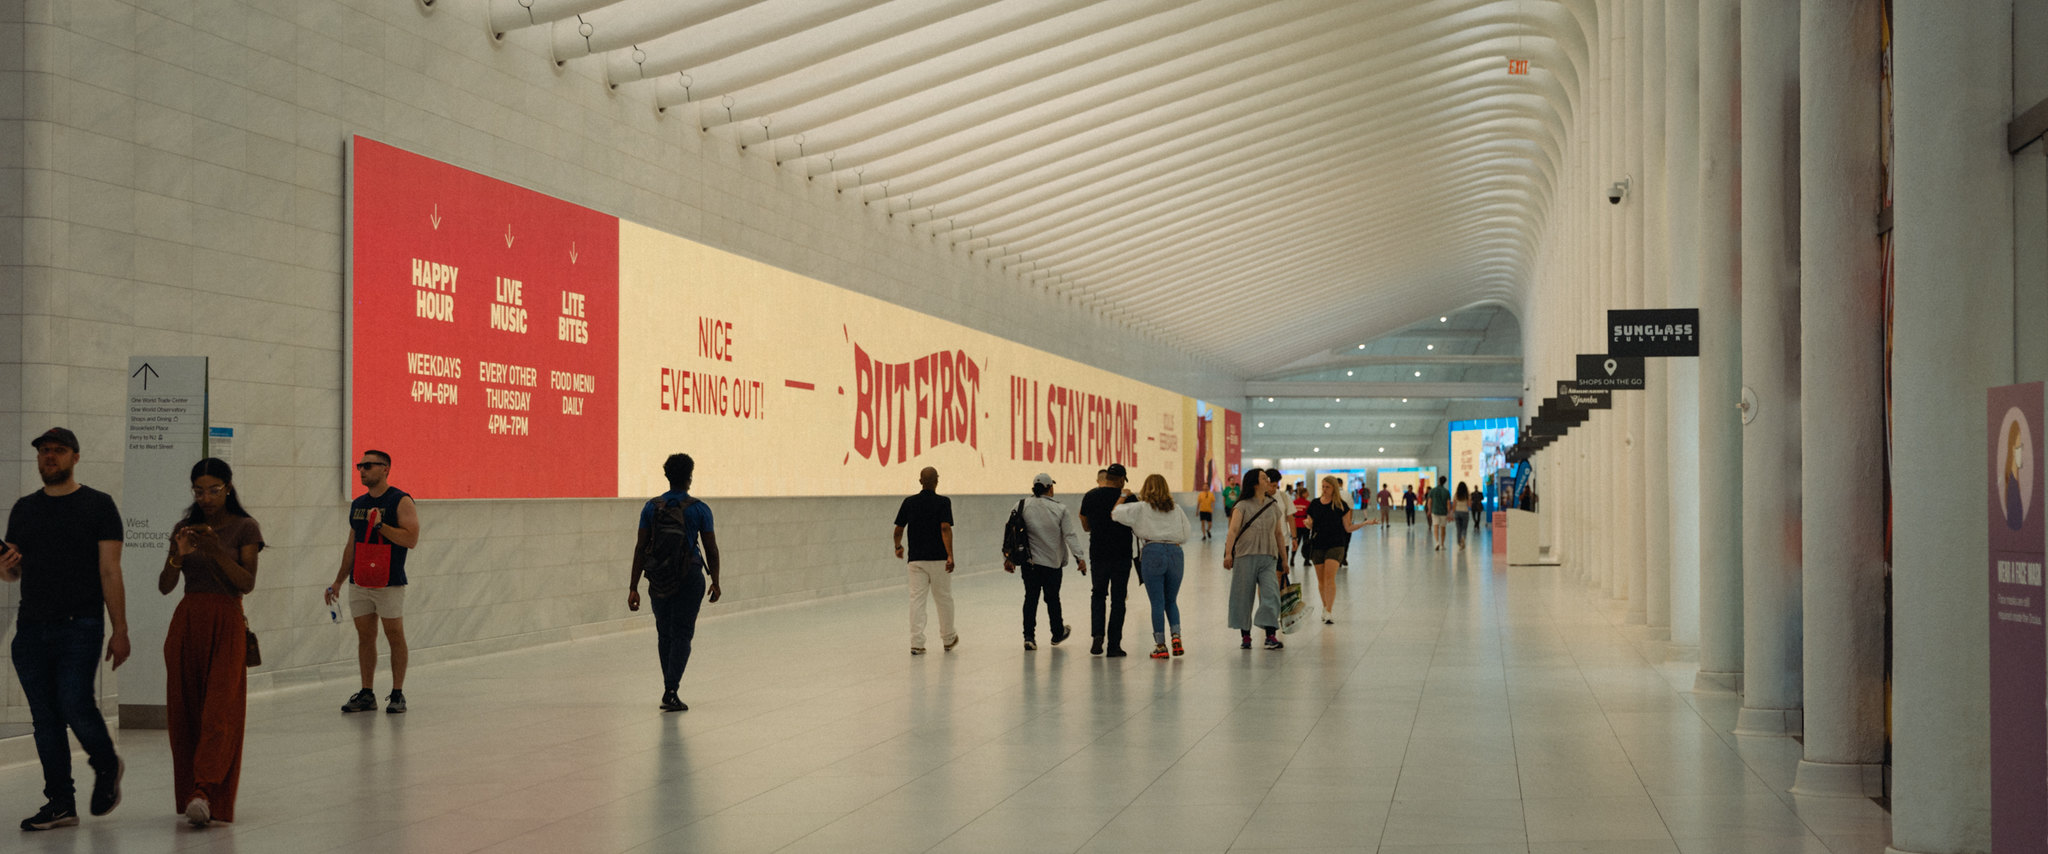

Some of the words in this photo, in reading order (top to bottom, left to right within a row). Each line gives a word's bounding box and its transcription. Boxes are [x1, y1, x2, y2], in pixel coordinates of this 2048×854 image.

[1508, 59, 1529, 75] EXIT
[412, 257, 459, 293] HAPPY
[496, 276, 523, 306] LIVE
[562, 290, 586, 318] LITE
[416, 289, 454, 323] HOUR
[490, 303, 528, 334] MUSIC
[558, 316, 589, 344] BITES
[698, 316, 733, 362] NICE
[1614, 324, 1693, 336] SUNGLASS
[407, 351, 462, 379] WEEKDAYS
[479, 360, 508, 384] EVERY
[508, 364, 537, 388] OTHER
[550, 370, 572, 391] FOOD
[572, 373, 595, 394] MENU
[660, 367, 728, 417] EVENING
[732, 377, 764, 420] OUT!
[1579, 378, 1602, 386] SHOPS
[1603, 378, 1615, 386] ON
[1616, 378, 1630, 386] THE
[1631, 378, 1643, 386] GO
[485, 387, 532, 411] THURSDAY
[562, 395, 584, 416] DAILY
[854, 341, 911, 467] BUT
[913, 349, 980, 458] FIRST
[1010, 375, 1044, 462] I'LL
[1047, 383, 1086, 465] STAY
[1087, 393, 1113, 466] FOR
[1115, 400, 1138, 468] ONE
[125, 529, 170, 540] Concours
[126, 517, 149, 528] West
